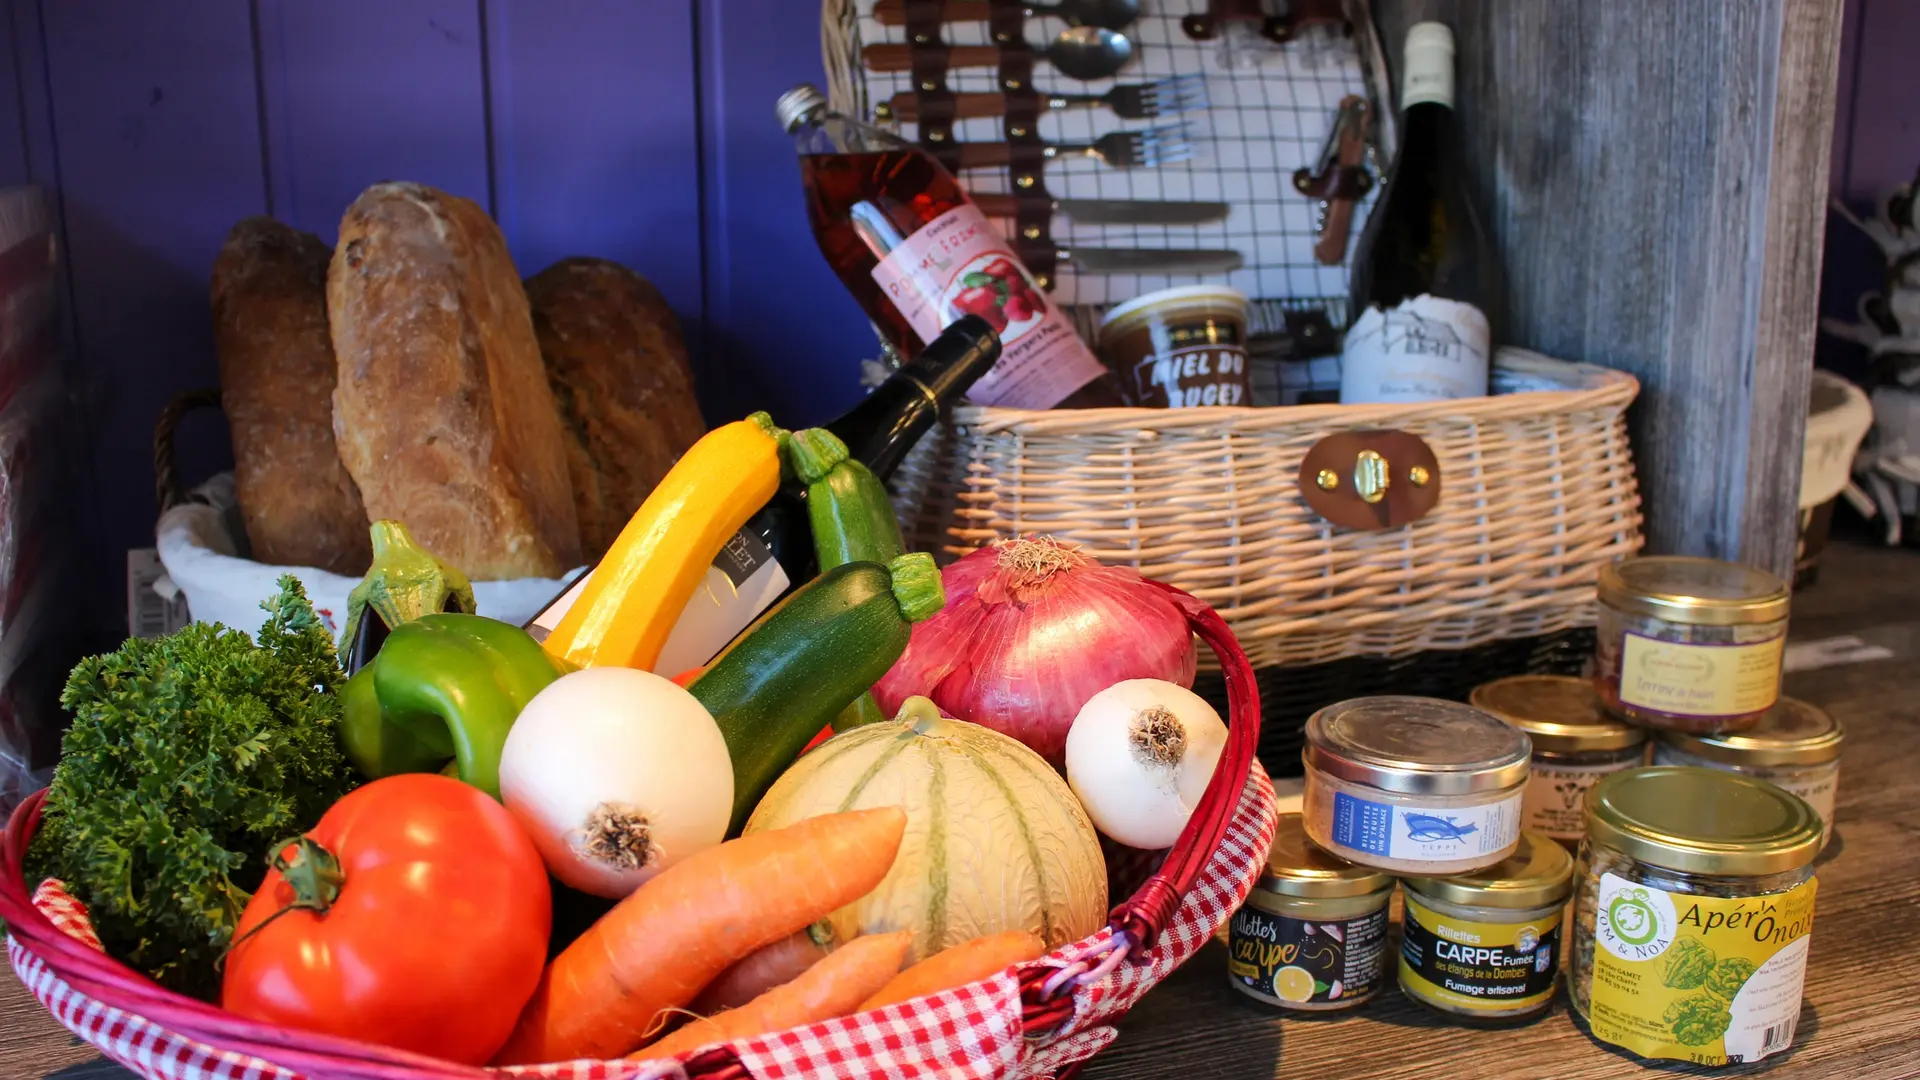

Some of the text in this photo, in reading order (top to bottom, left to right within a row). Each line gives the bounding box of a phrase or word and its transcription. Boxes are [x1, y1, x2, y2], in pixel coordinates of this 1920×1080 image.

[1437, 924, 1481, 944] Rillettes
[1436, 940, 1535, 967] CARPE Fumée
[1635, 938, 1669, 959] NOA
[1475, 970, 1485, 979] de
[1493, 967, 1527, 980] Dombes
[1445, 978, 1527, 996] Fumage artisanal
